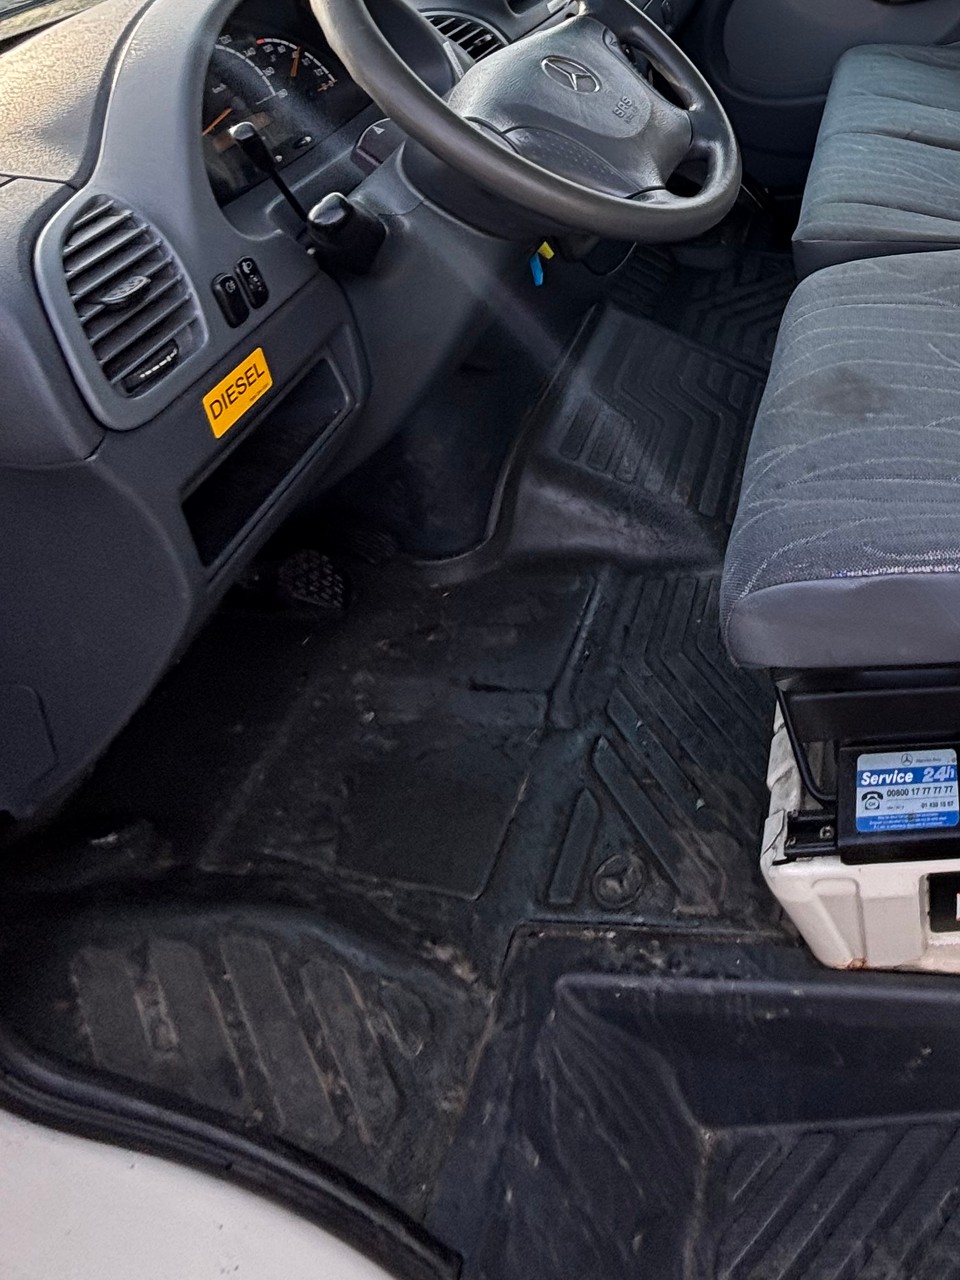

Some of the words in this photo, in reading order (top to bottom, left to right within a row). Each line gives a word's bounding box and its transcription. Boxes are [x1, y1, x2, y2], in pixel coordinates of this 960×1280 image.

[612, 96, 632, 118] SRS
[209, 363, 265, 420] DIESEL
[861, 769, 914, 785] Service
[922, 766, 955, 782] 24h
[886, 788, 909, 797] 00800
[911, 788, 920, 796] 17
[922, 787, 931, 795] 77
[933, 786, 942, 794] 77
[944, 785, 953, 793] 77
